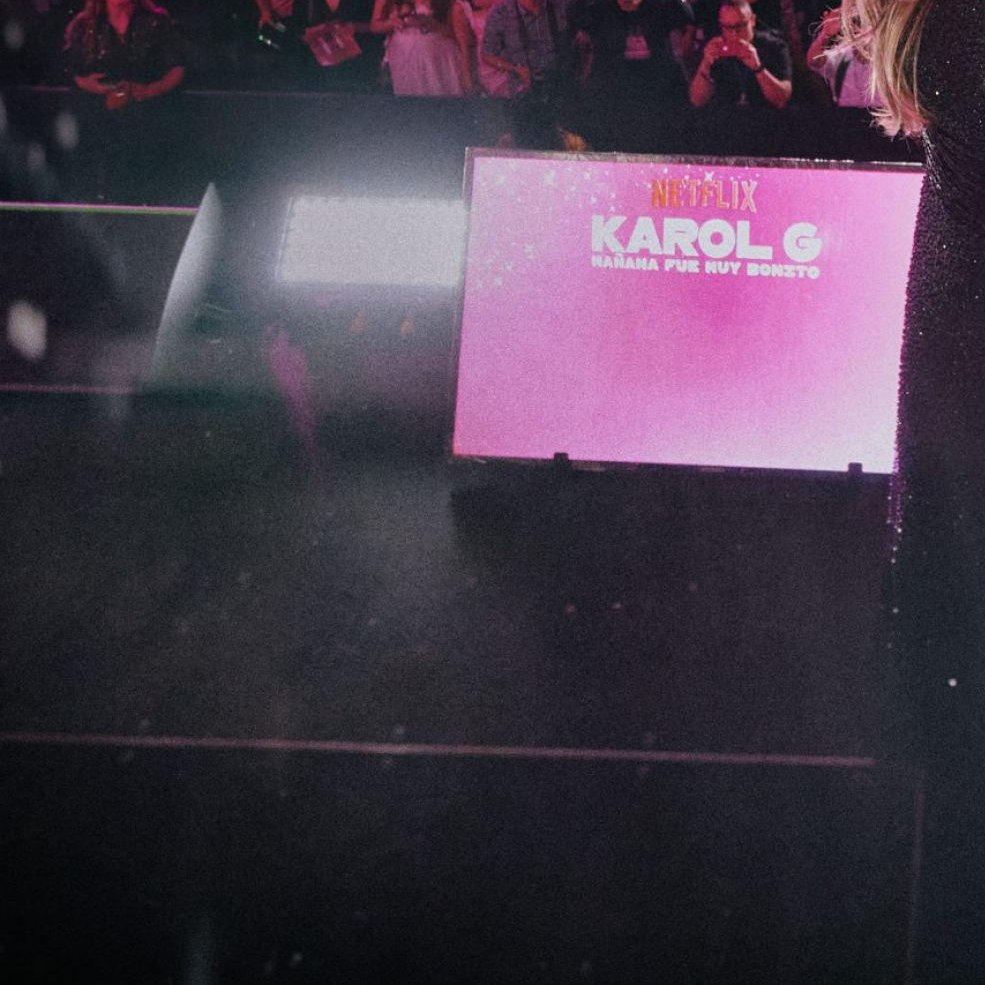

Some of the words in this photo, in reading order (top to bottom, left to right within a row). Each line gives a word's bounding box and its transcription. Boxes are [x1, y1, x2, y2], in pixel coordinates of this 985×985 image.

[652, 178, 758, 213] NETFLIX
[591, 215, 773, 260] KAROL
[783, 222, 822, 263] G
[591, 253, 659, 272] MAÑANA
[665, 258, 700, 274] FUE
[705, 261, 742, 275] MUY
[746, 263, 820, 280] BONITO
